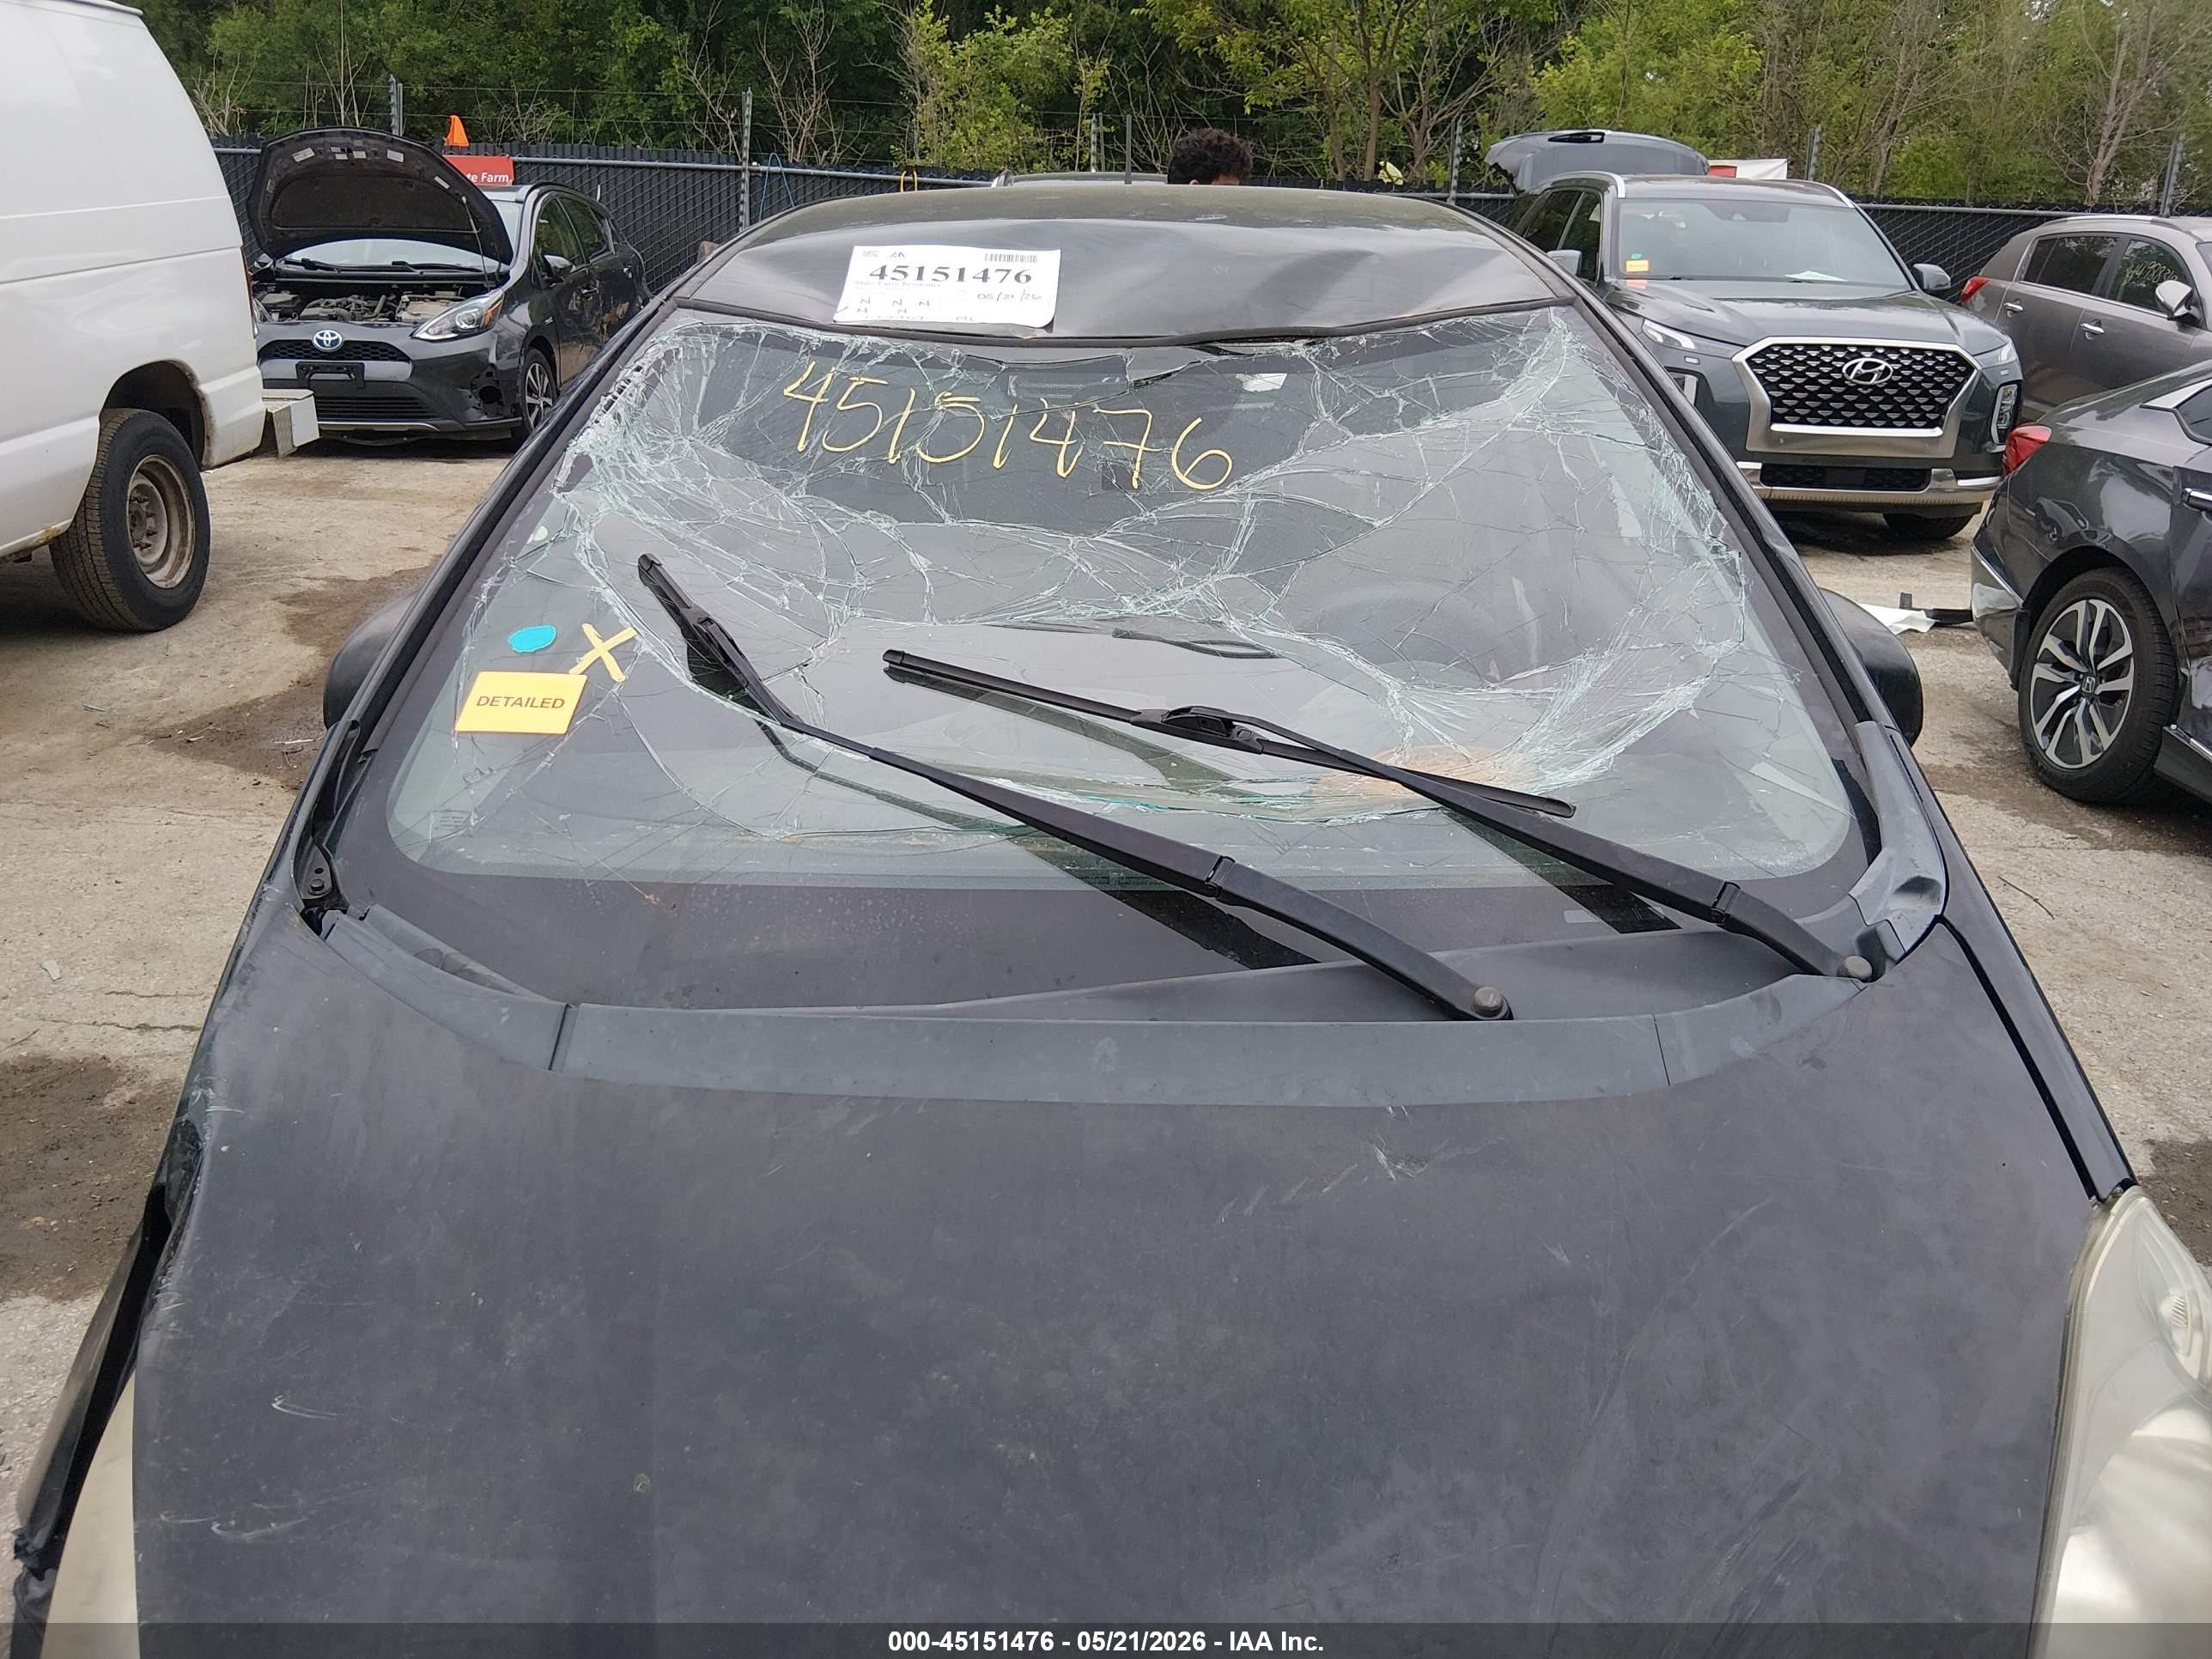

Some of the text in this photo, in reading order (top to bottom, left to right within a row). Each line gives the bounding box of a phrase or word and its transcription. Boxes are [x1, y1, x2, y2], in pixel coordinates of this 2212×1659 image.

[480, 172, 509, 183] Farm
[869, 264, 1032, 283] 45151476
[783, 361, 1233, 490] 45151476
[476, 696, 566, 709] DETAILED
